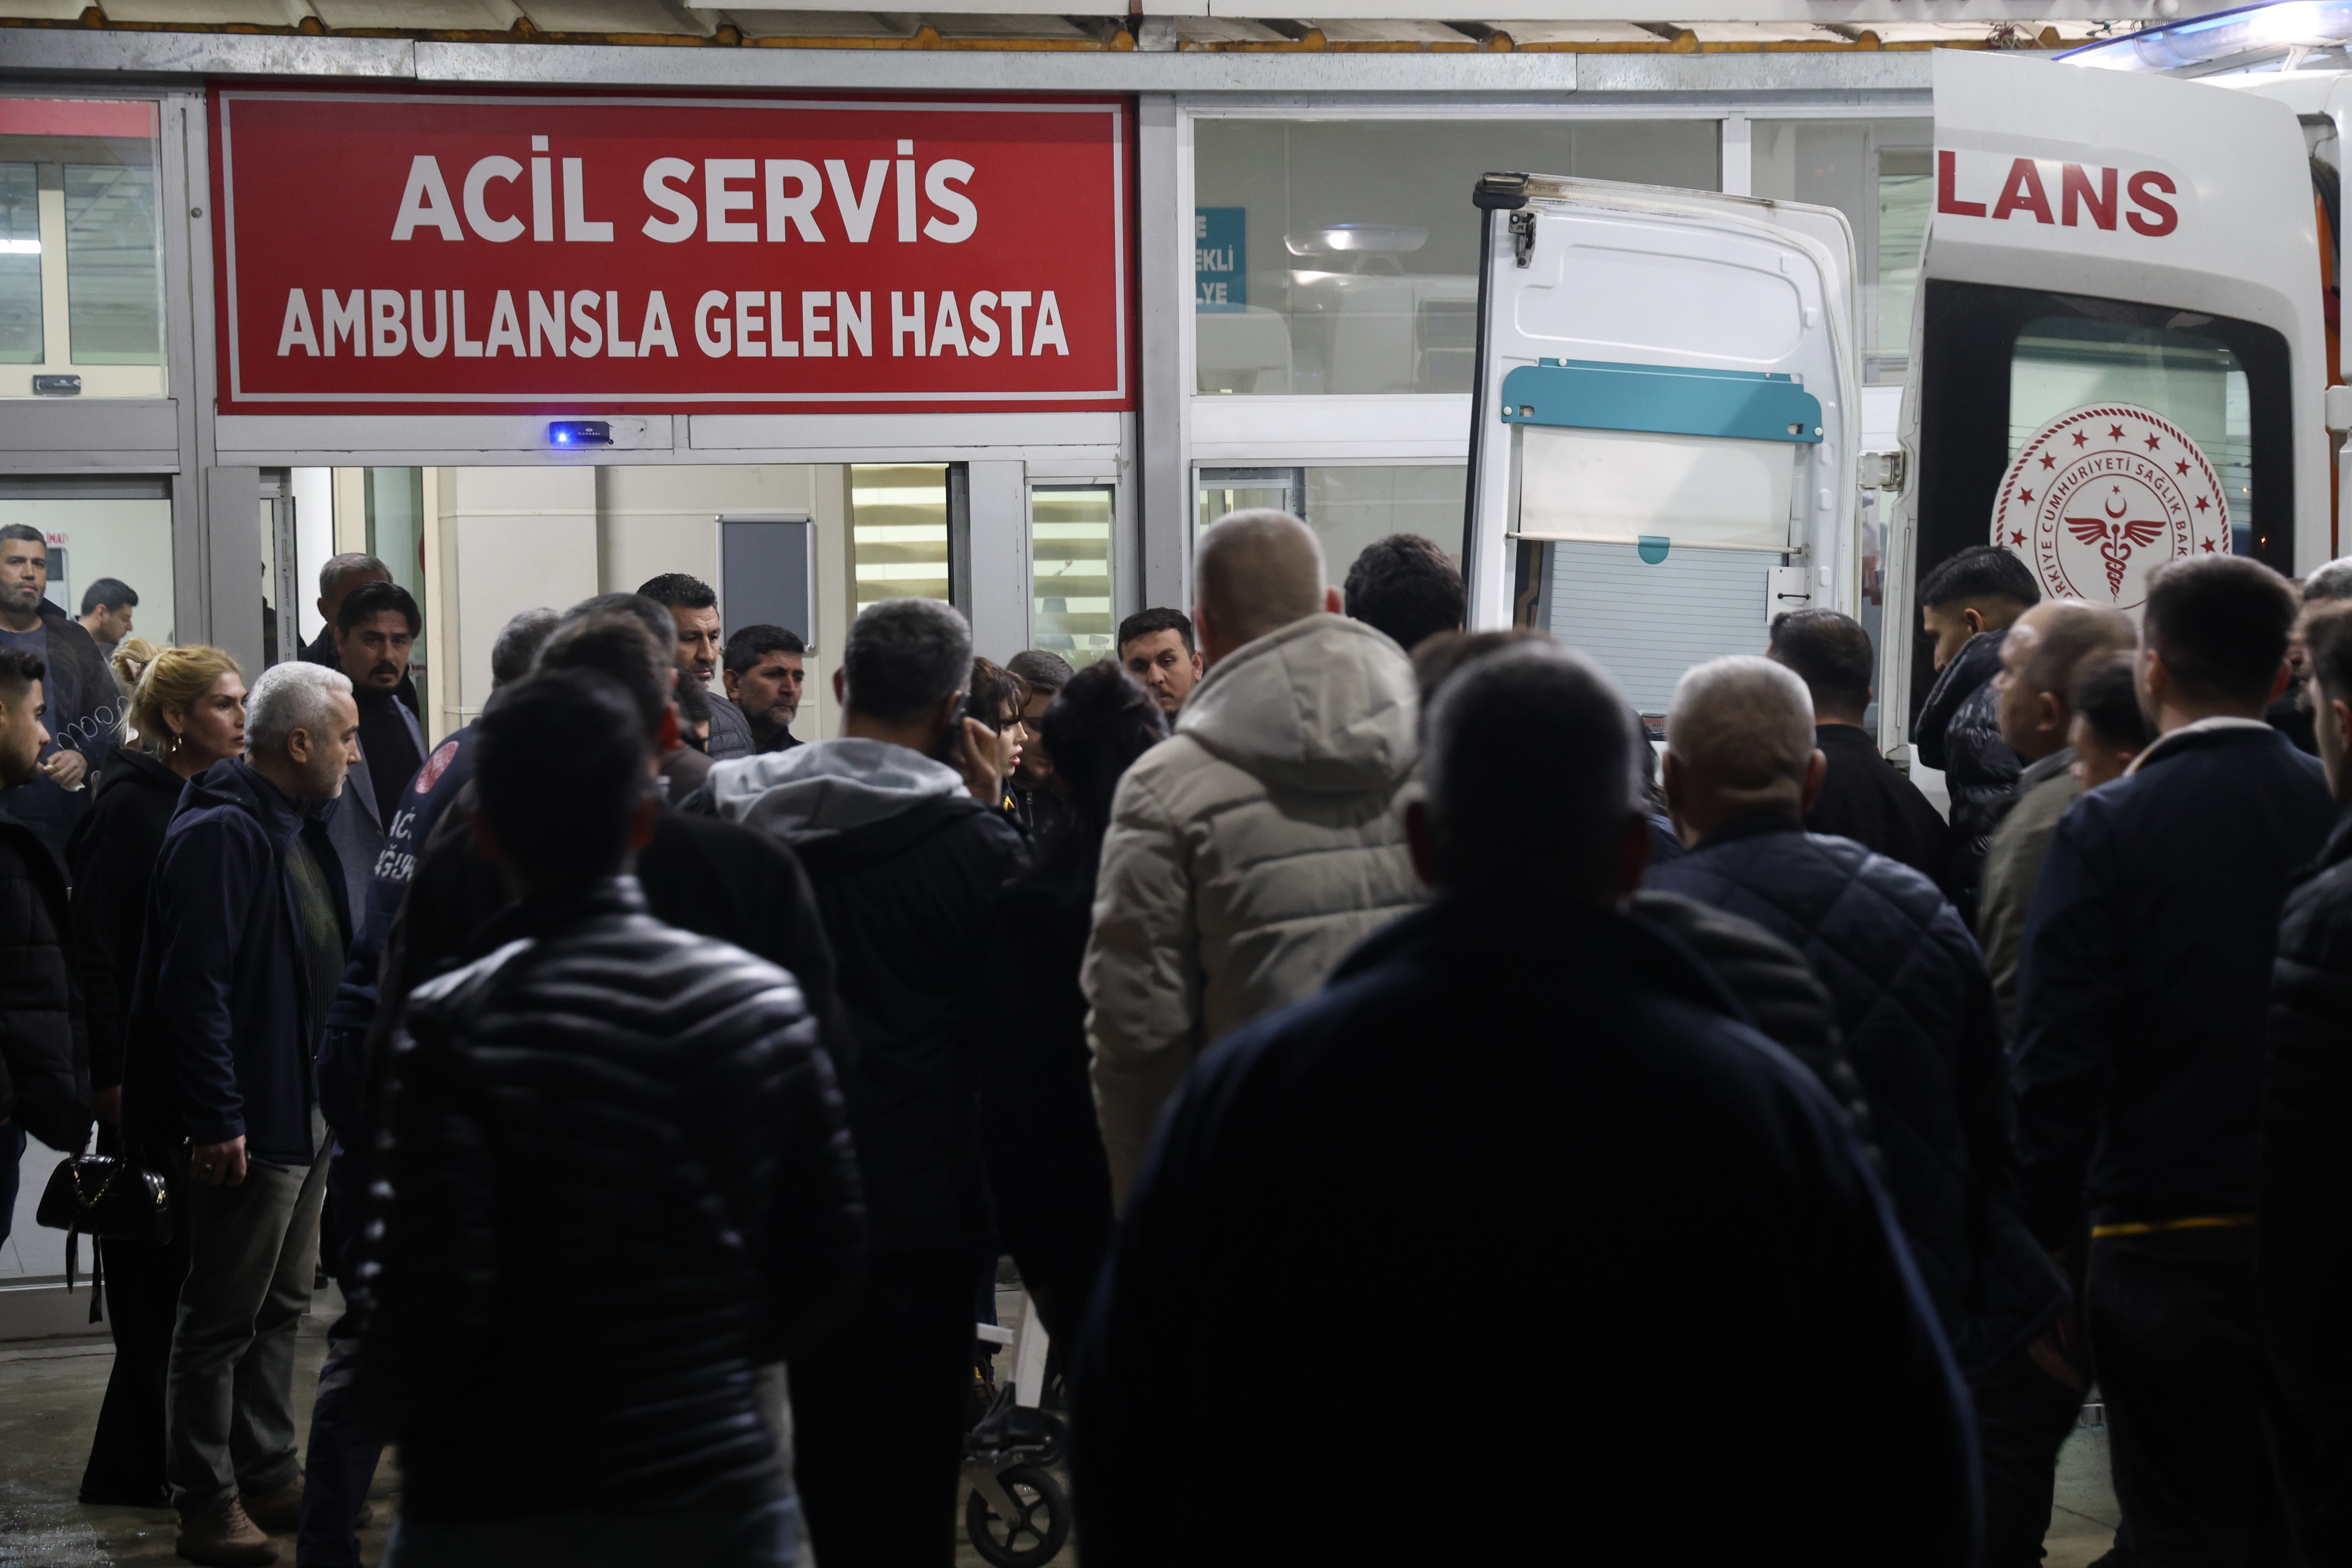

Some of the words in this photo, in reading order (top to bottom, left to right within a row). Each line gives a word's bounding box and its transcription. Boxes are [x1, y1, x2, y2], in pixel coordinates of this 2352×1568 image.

[391, 135, 614, 242] ACİL
[642, 139, 977, 243] SERVİS
[1938, 150, 2178, 237] LANS
[1196, 244, 1234, 271] EKLİ
[1196, 282, 1227, 304] LYE
[278, 288, 679, 358] AMBULANSLA
[695, 290, 873, 358] GELEN
[891, 290, 1070, 357] HASTA
[2042, 457, 2130, 533] CUMHURİYETİ
[2135, 464, 2182, 515] SAĞLIK
[2176, 521, 2188, 556] BAK
[2041, 541, 2073, 598] RKİYE
